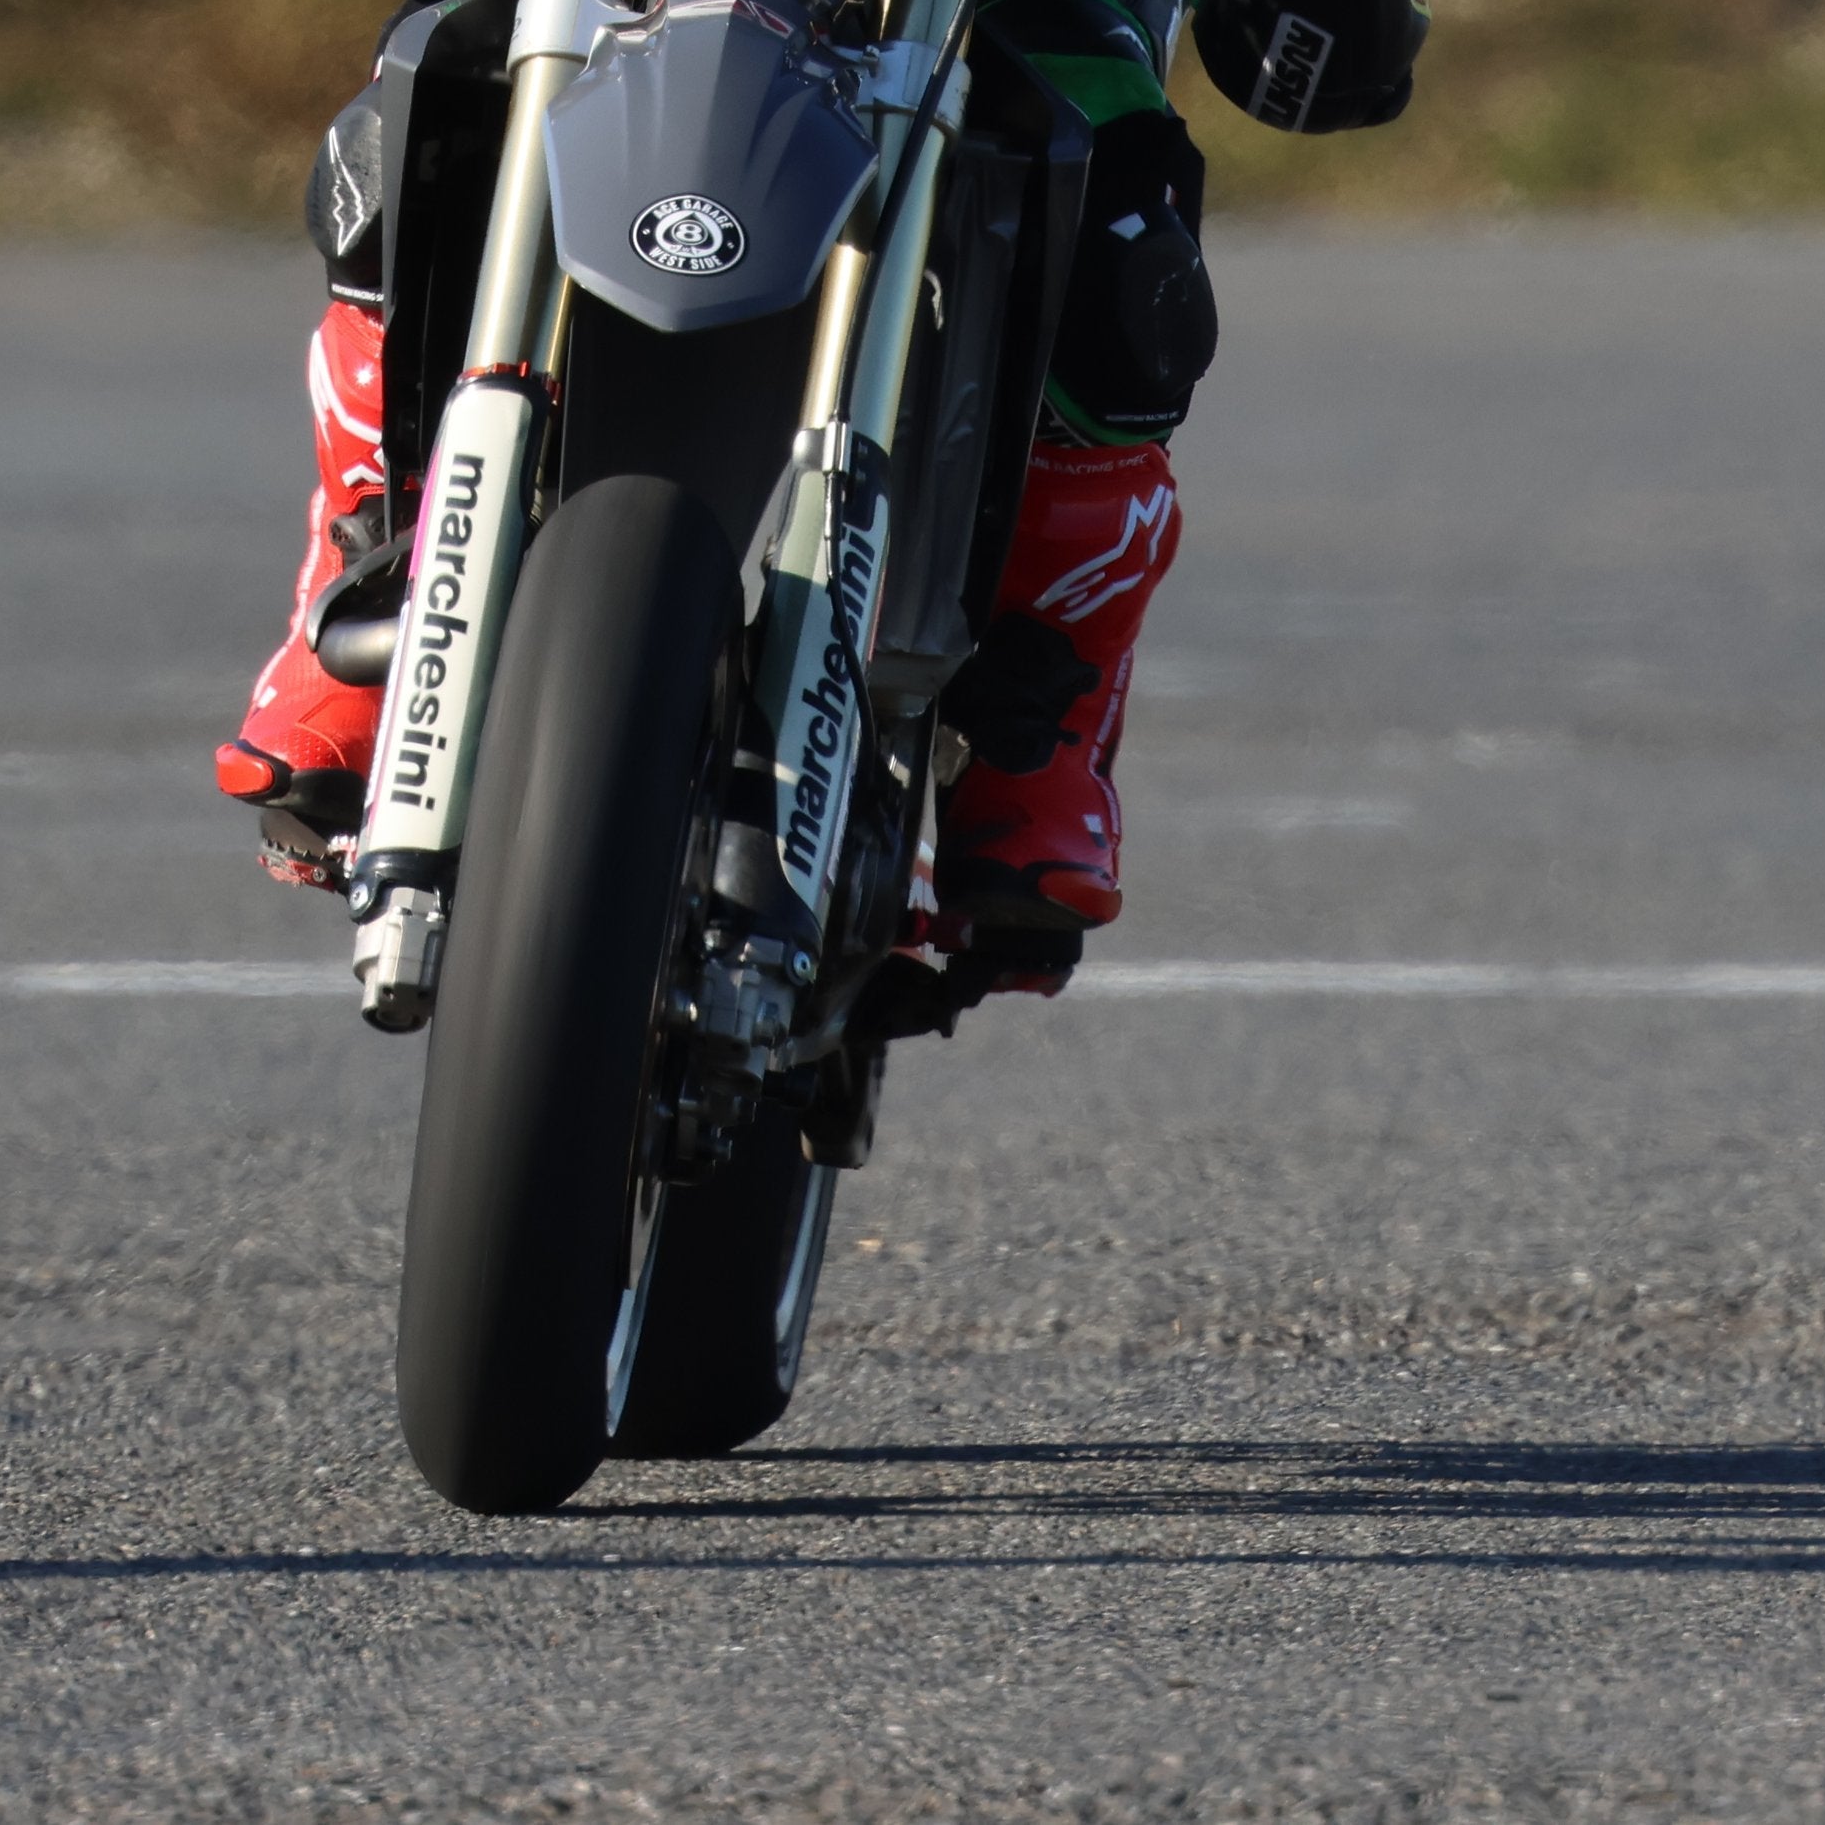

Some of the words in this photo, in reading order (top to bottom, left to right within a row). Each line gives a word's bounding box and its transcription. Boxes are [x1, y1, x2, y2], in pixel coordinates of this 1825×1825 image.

[653, 201, 680, 219] ACE
[682, 198, 734, 229] GARAGE
[675, 223, 703, 242] 8
[648, 246, 686, 269] WEST
[690, 255, 723, 270] SIDE
[389, 452, 485, 811] marchesini
[784, 526, 876, 877] marchesini
